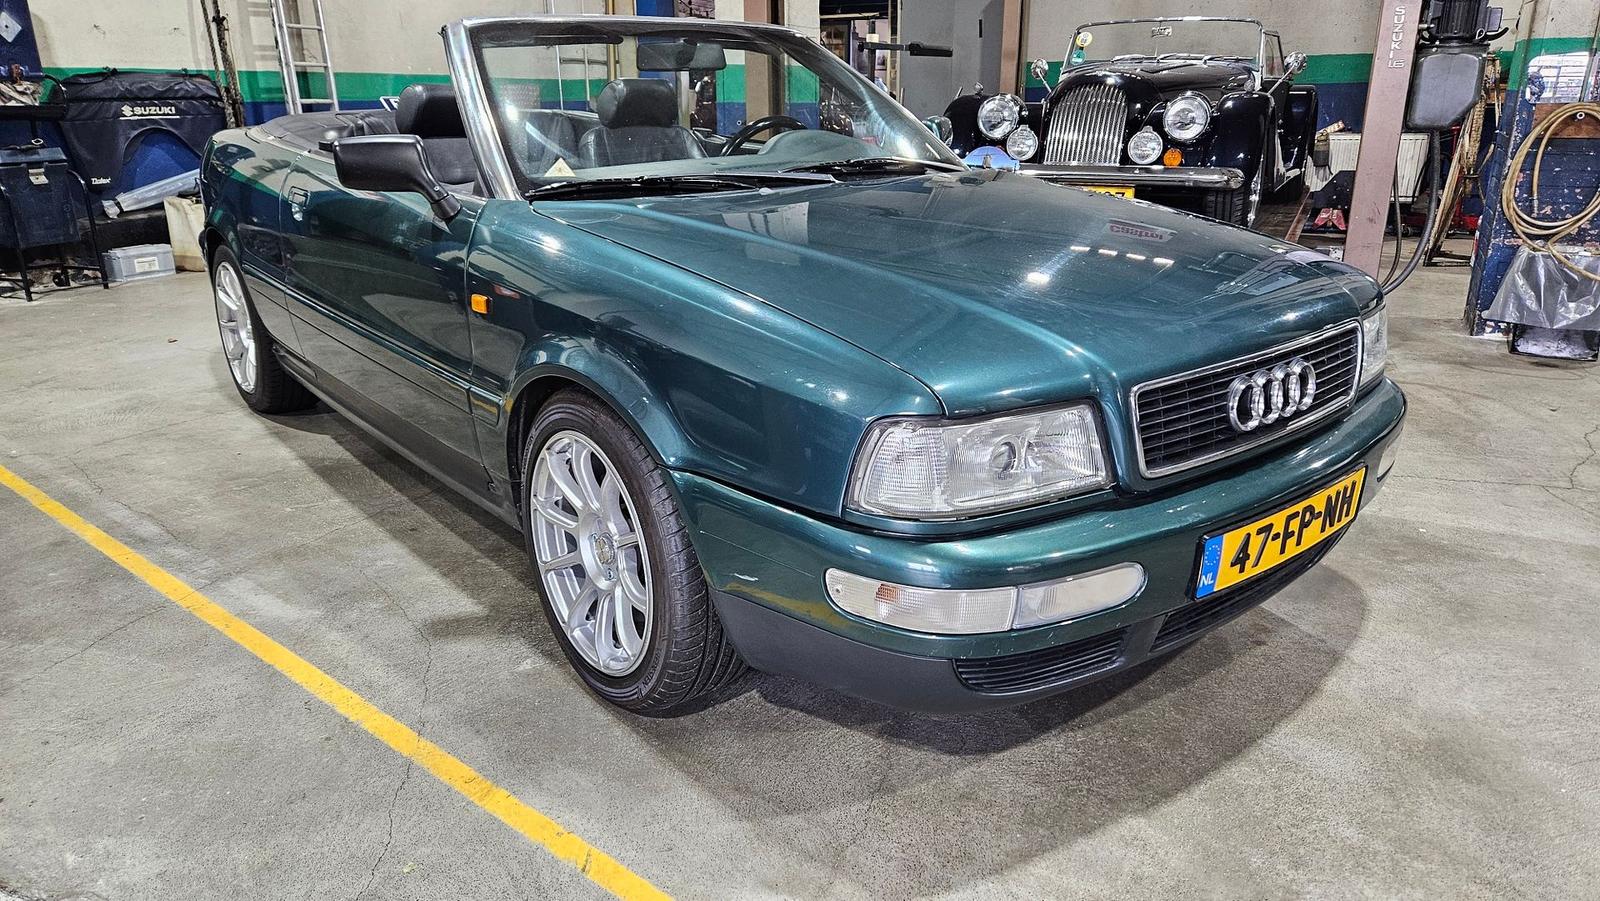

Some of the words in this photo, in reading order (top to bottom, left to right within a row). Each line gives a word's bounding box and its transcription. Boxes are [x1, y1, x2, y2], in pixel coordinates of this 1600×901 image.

[1389, 5, 1406, 59] SUZUKI
[133, 106, 176, 115] SUZUKI
[1229, 480, 1357, 574] 47-FP-NH
[1200, 572, 1214, 587] NL
